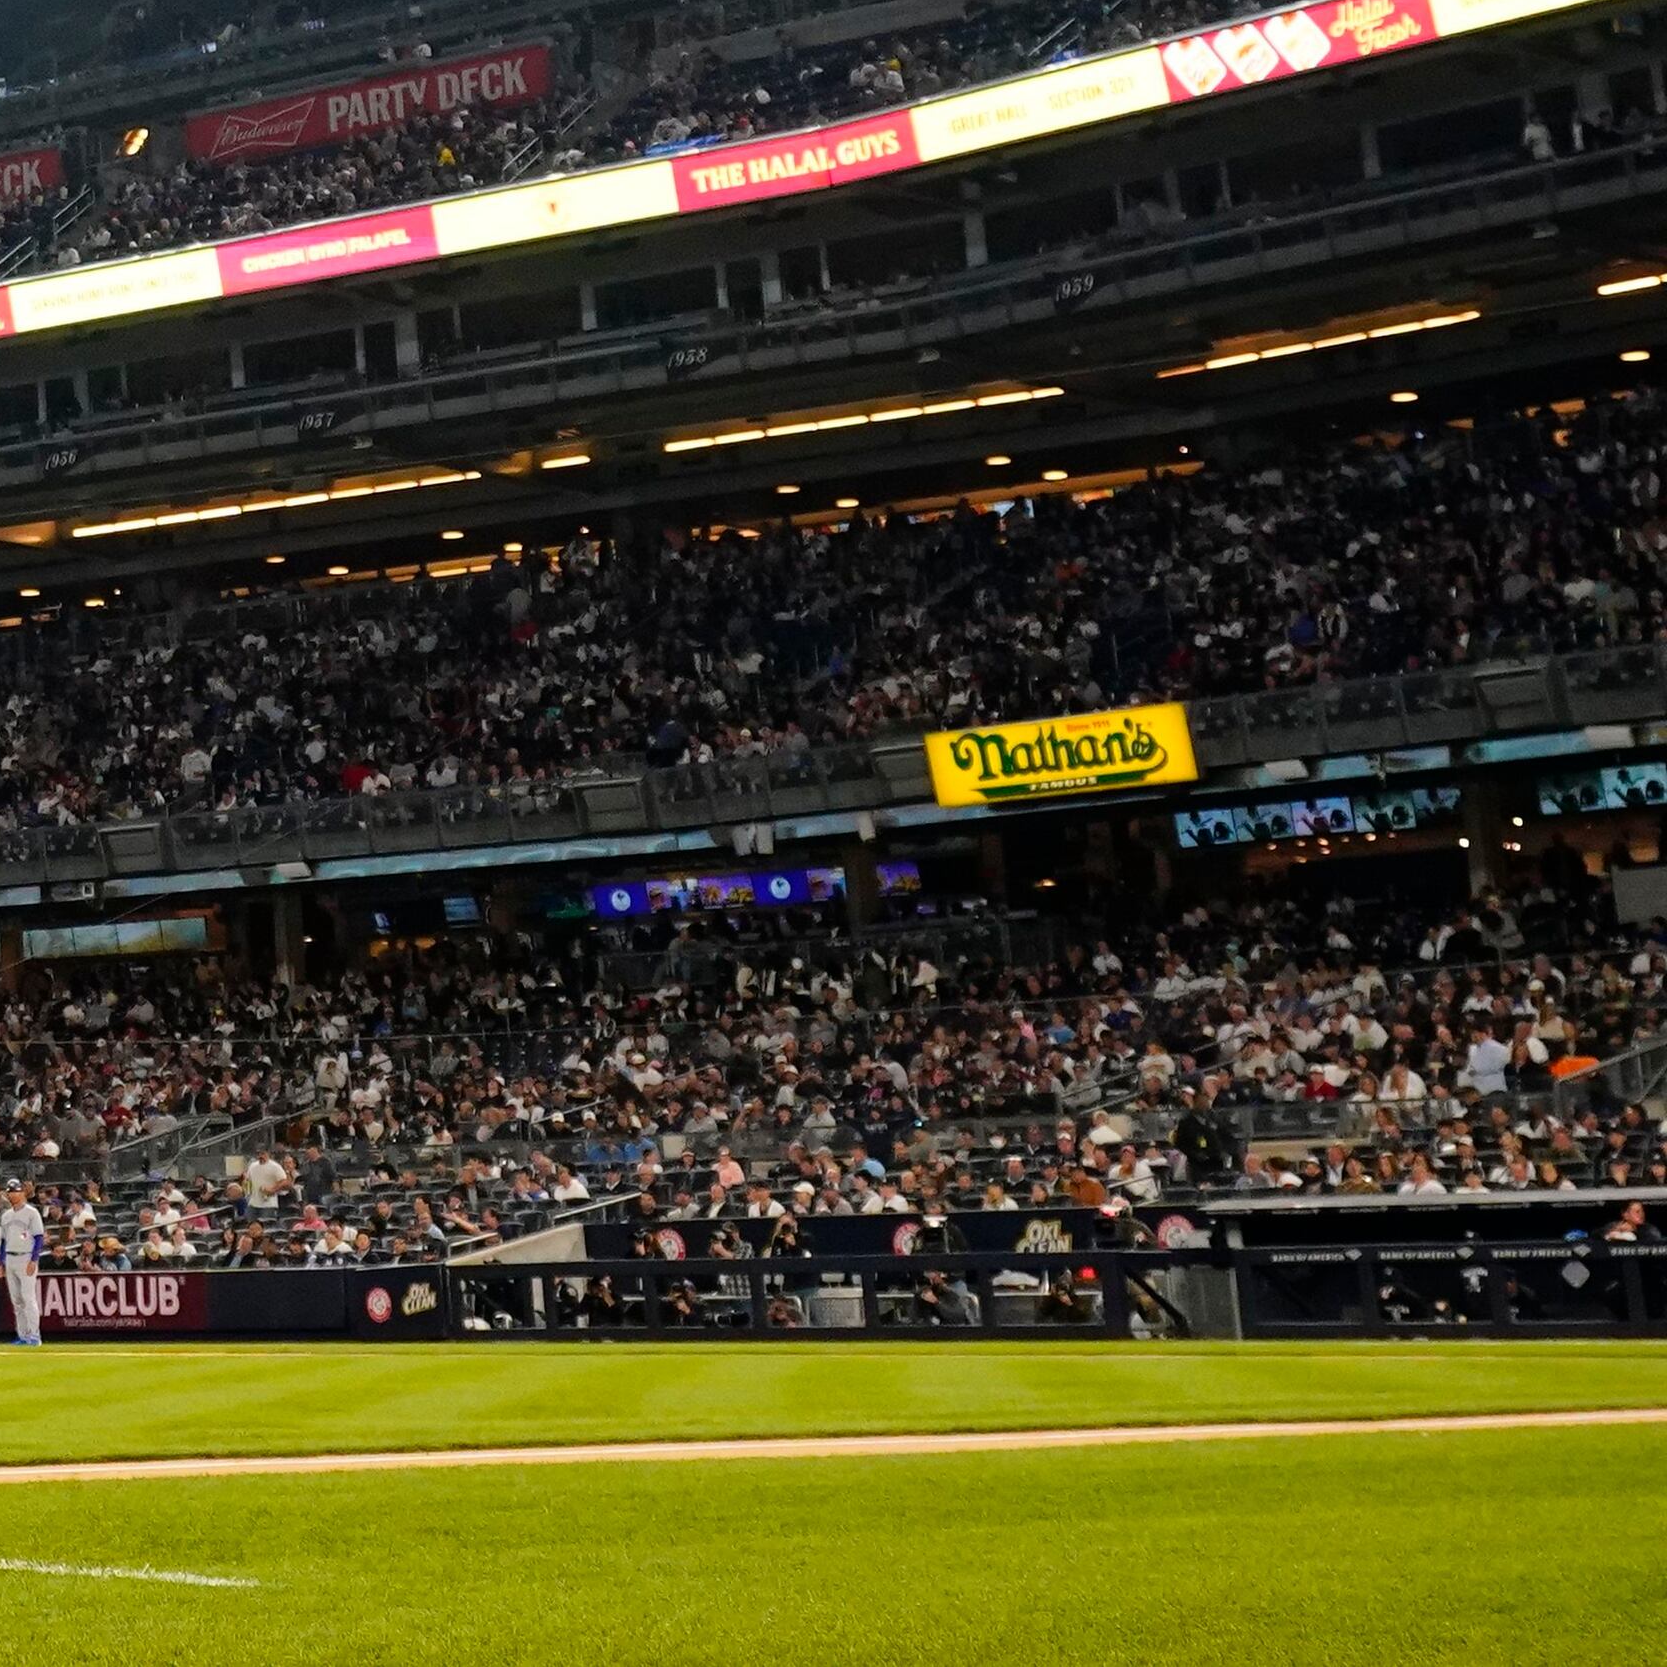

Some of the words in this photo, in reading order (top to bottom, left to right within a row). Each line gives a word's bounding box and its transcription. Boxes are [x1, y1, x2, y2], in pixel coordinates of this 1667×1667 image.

[1354, 13, 1421, 56] Fresh
[328, 77, 427, 134] PARTY
[435, 57, 526, 110] DECK
[221, 117, 307, 145] Budweiser
[691, 162, 746, 193] THE
[749, 148, 836, 183] HALAL
[837, 130, 901, 164] GUYS
[950, 718, 1168, 781] Nathan's
[1029, 776, 1097, 792] FAMOUS
[1027, 1219, 1062, 1241] OXI
